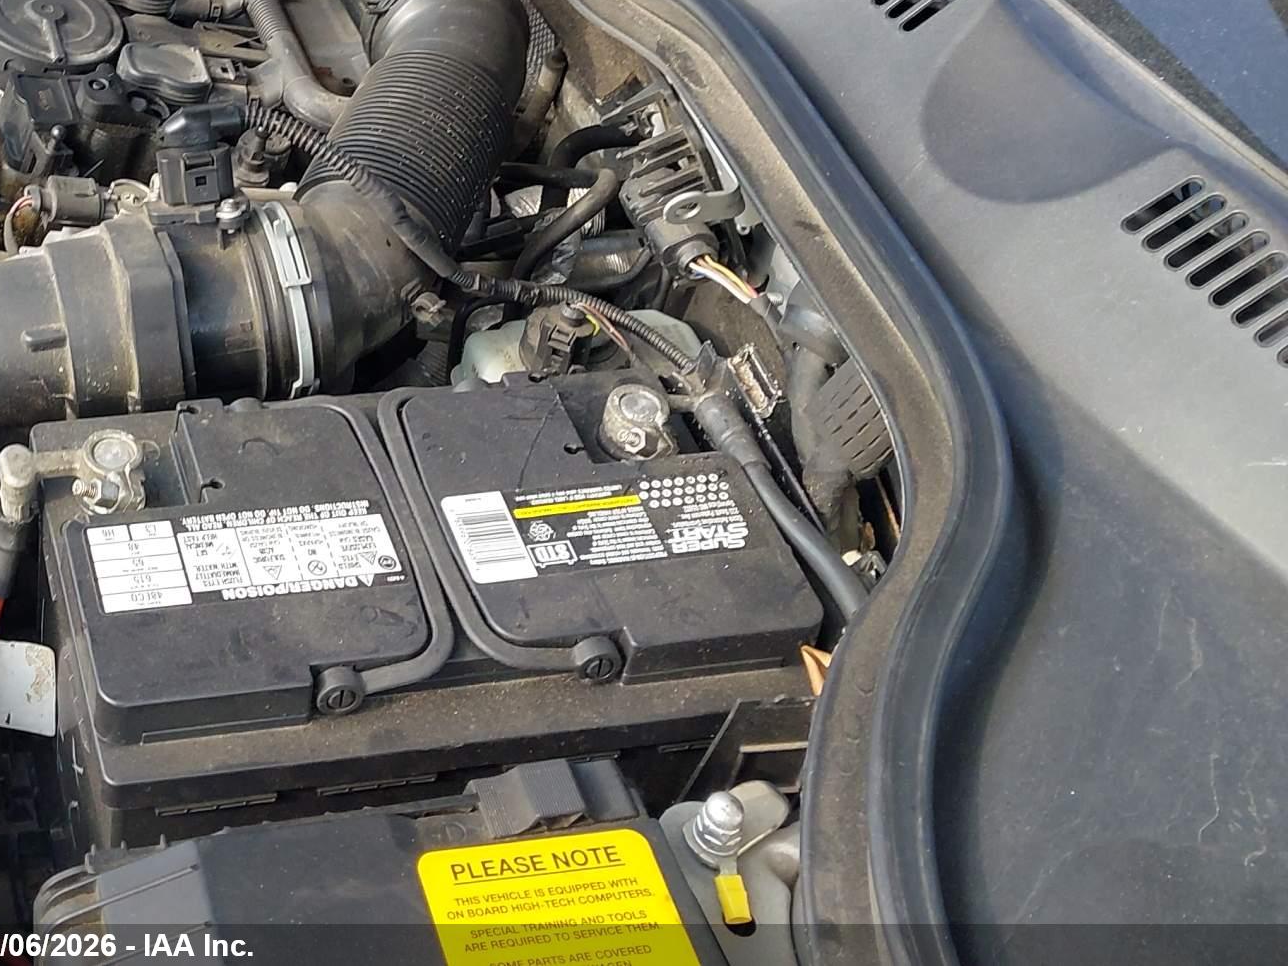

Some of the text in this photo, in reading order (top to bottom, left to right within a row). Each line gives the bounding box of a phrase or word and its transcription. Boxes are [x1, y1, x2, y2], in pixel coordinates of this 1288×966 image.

[667, 521, 749, 542] START
[672, 538, 746, 553] SUPER
[222, 576, 358, 600] DANGER/POISON
[450, 845, 621, 880] PLEASE NOTE
[447, 888, 654, 920] ON BOARD HIGH-TECH COMPUTERS.
[455, 877, 638, 907] THIS VEHICLE IS EQUIPPED WITH
[470, 910, 648, 939] SPECIAL TRAINING AND TOOLS
[464, 941, 488, 953] ARE
[491, 934, 552, 949] REQUIRED
[555, 932, 570, 942] TO
[573, 925, 624, 940] SERVICE
[527, 955, 566, 966] PARTS
[569, 952, 592, 963] ARE
[595, 944, 651, 960] COVERED
